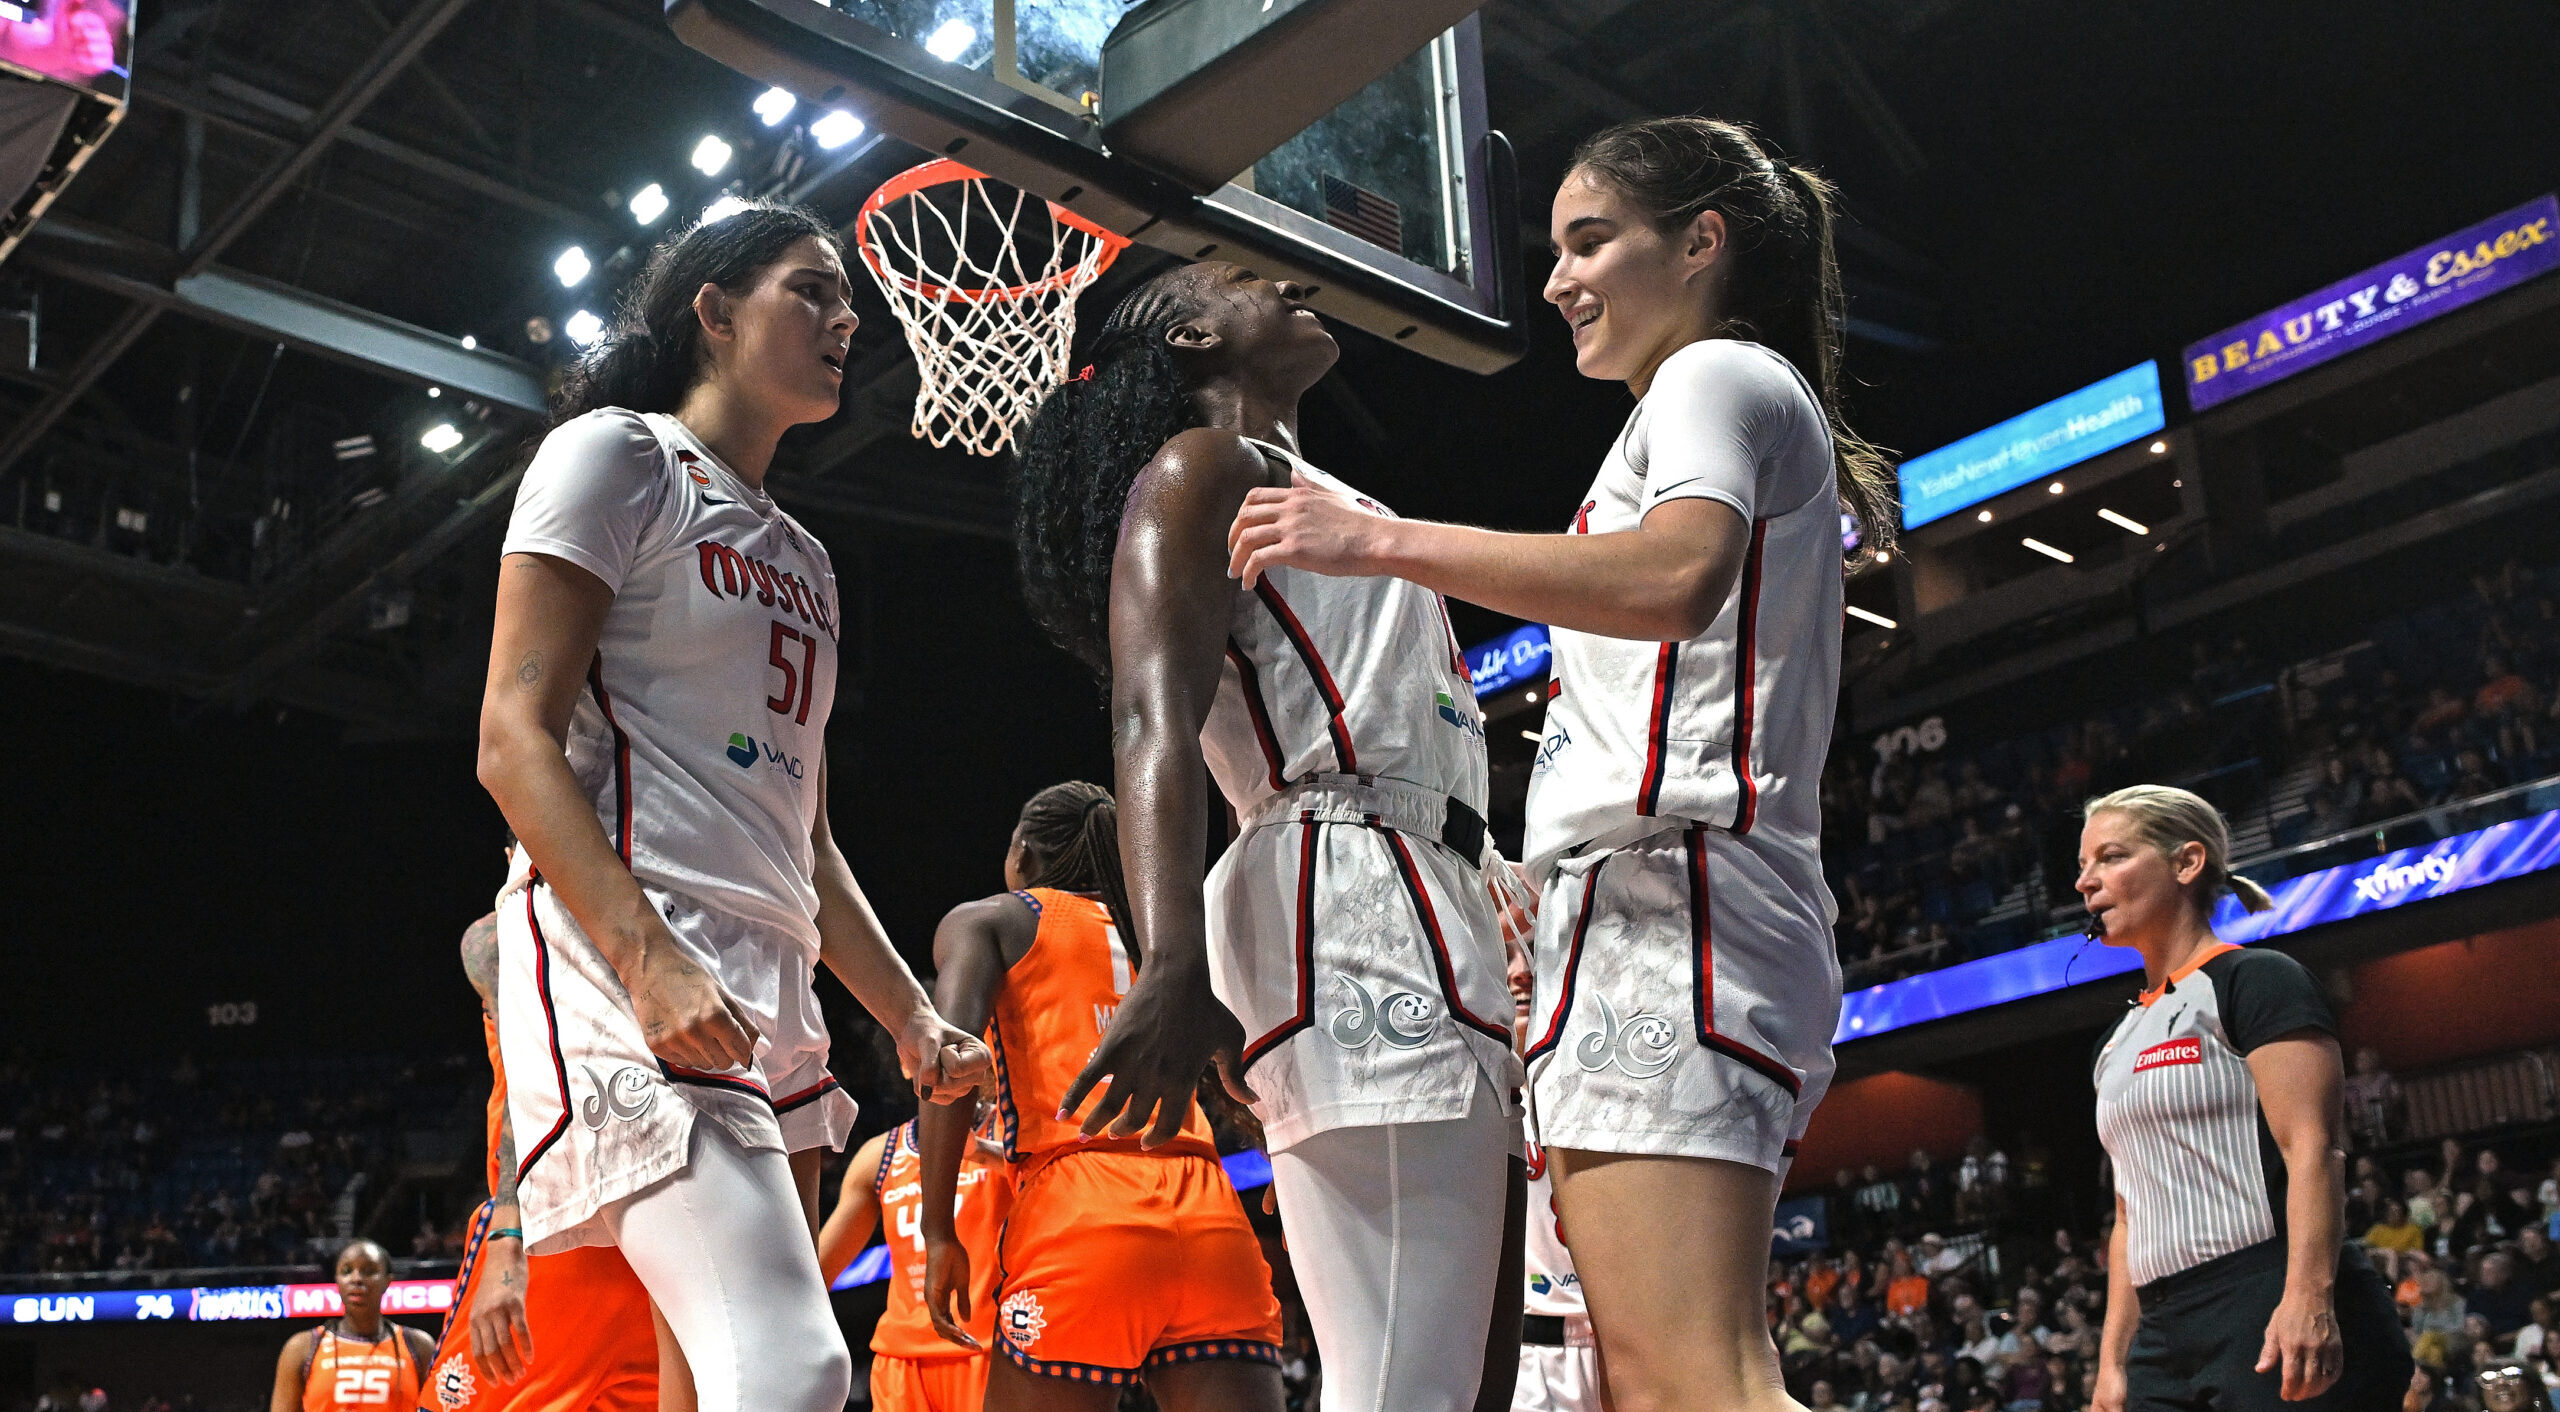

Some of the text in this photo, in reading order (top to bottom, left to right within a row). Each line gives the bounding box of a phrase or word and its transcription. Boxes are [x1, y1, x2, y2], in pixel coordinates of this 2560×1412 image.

[2191, 283, 2379, 384] BEAUTY
[2385, 272, 2420, 304] &
[767, 620, 816, 726] 51
[2353, 854, 2458, 901] xfinity
[209, 1002, 257, 1026] 103
[2136, 1045, 2200, 1069] Emirates
[13, 1296, 94, 1323] SUN
[136, 1294, 174, 1320] 74
[334, 1369, 391, 1404] 25
